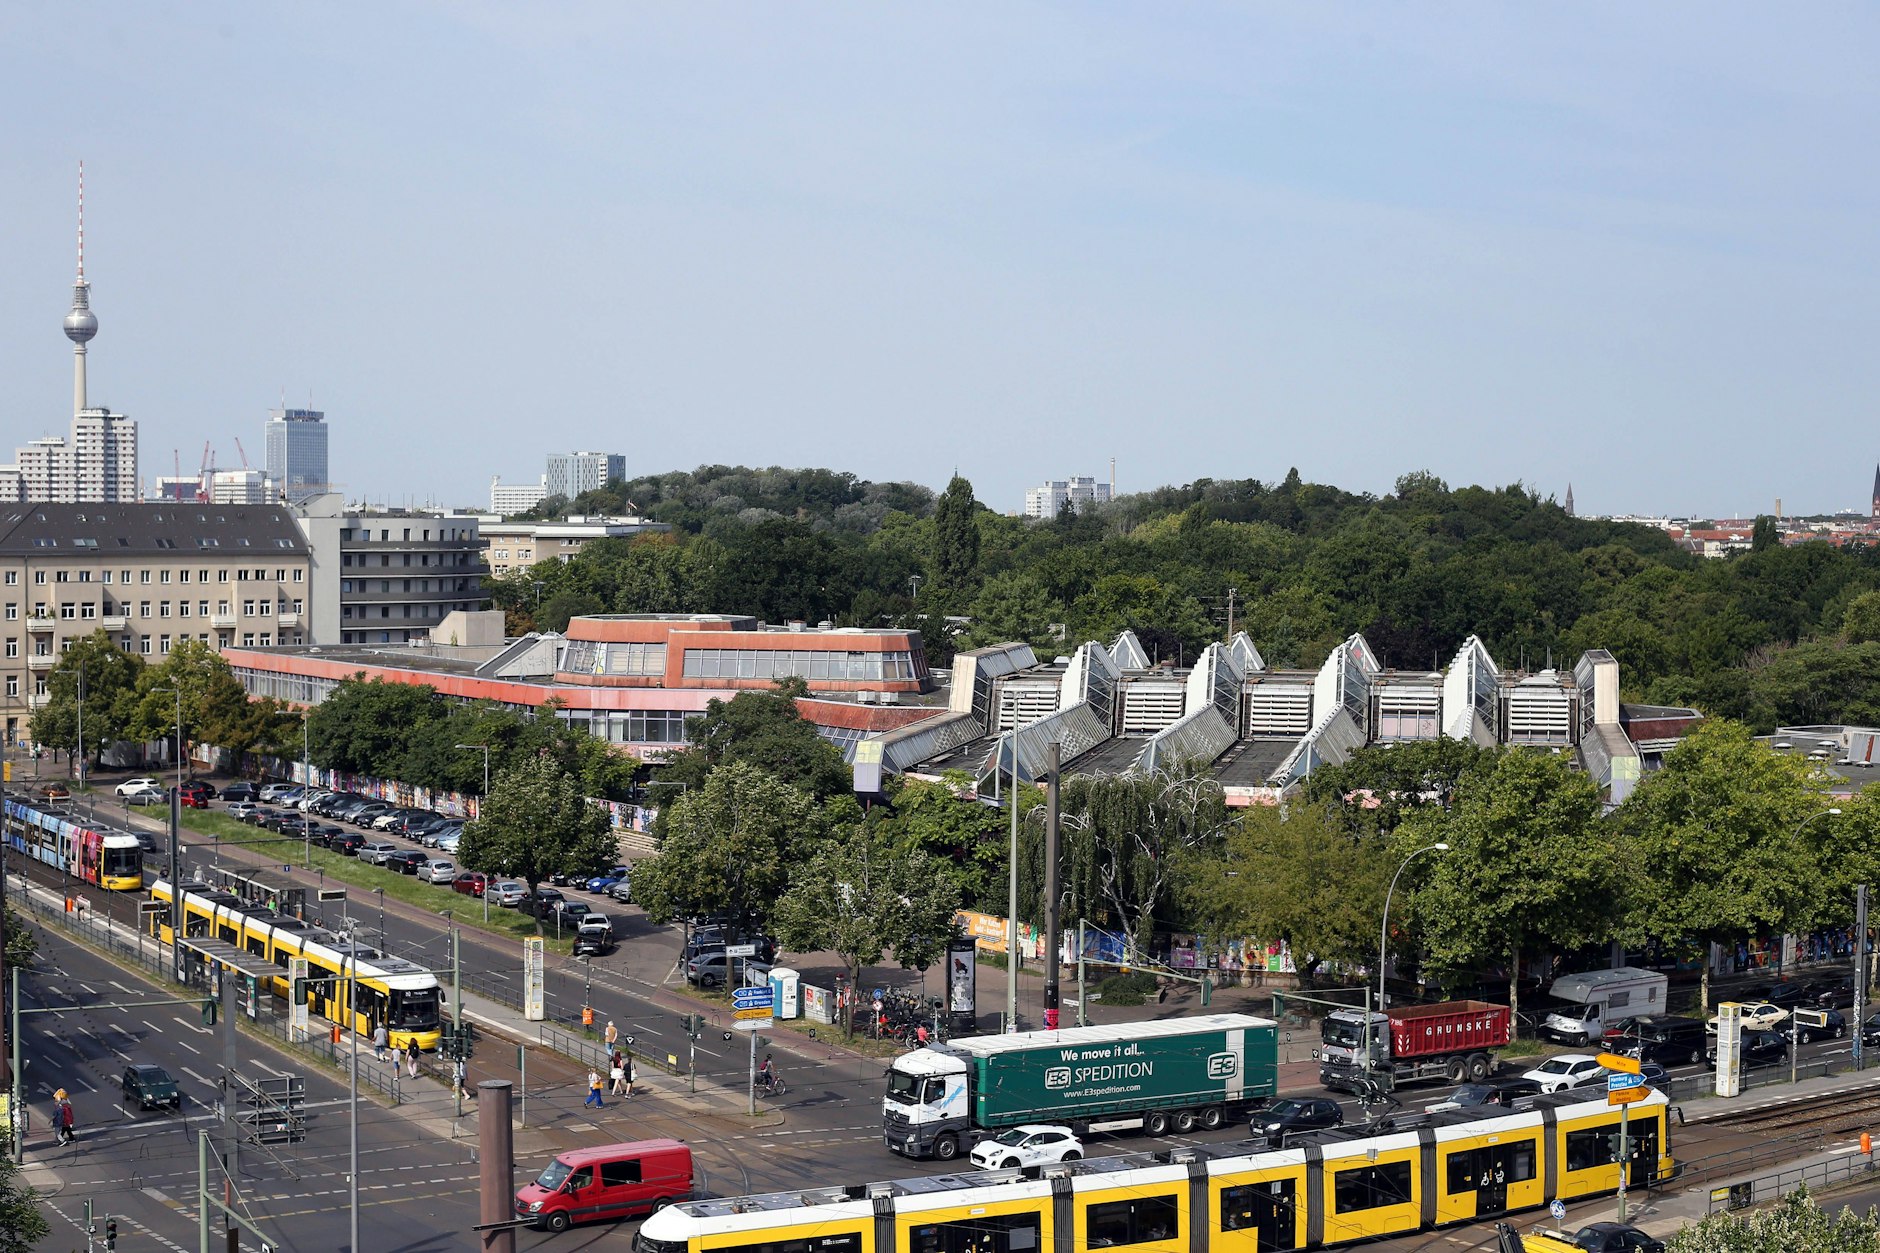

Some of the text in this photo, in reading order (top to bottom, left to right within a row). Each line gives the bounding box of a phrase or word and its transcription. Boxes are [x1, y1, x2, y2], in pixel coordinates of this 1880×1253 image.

[1426, 1020, 1491, 1036] GRUNSKE
[1060, 1050, 1078, 1061] We
[1081, 1049, 1111, 1060] move
[1114, 1045, 1121, 1056] it
[1046, 1061, 1153, 1086] E3 SPEDITION
[1209, 1056, 1235, 1075] E3
[1063, 1084, 1140, 1098] www.E3spedition.com
